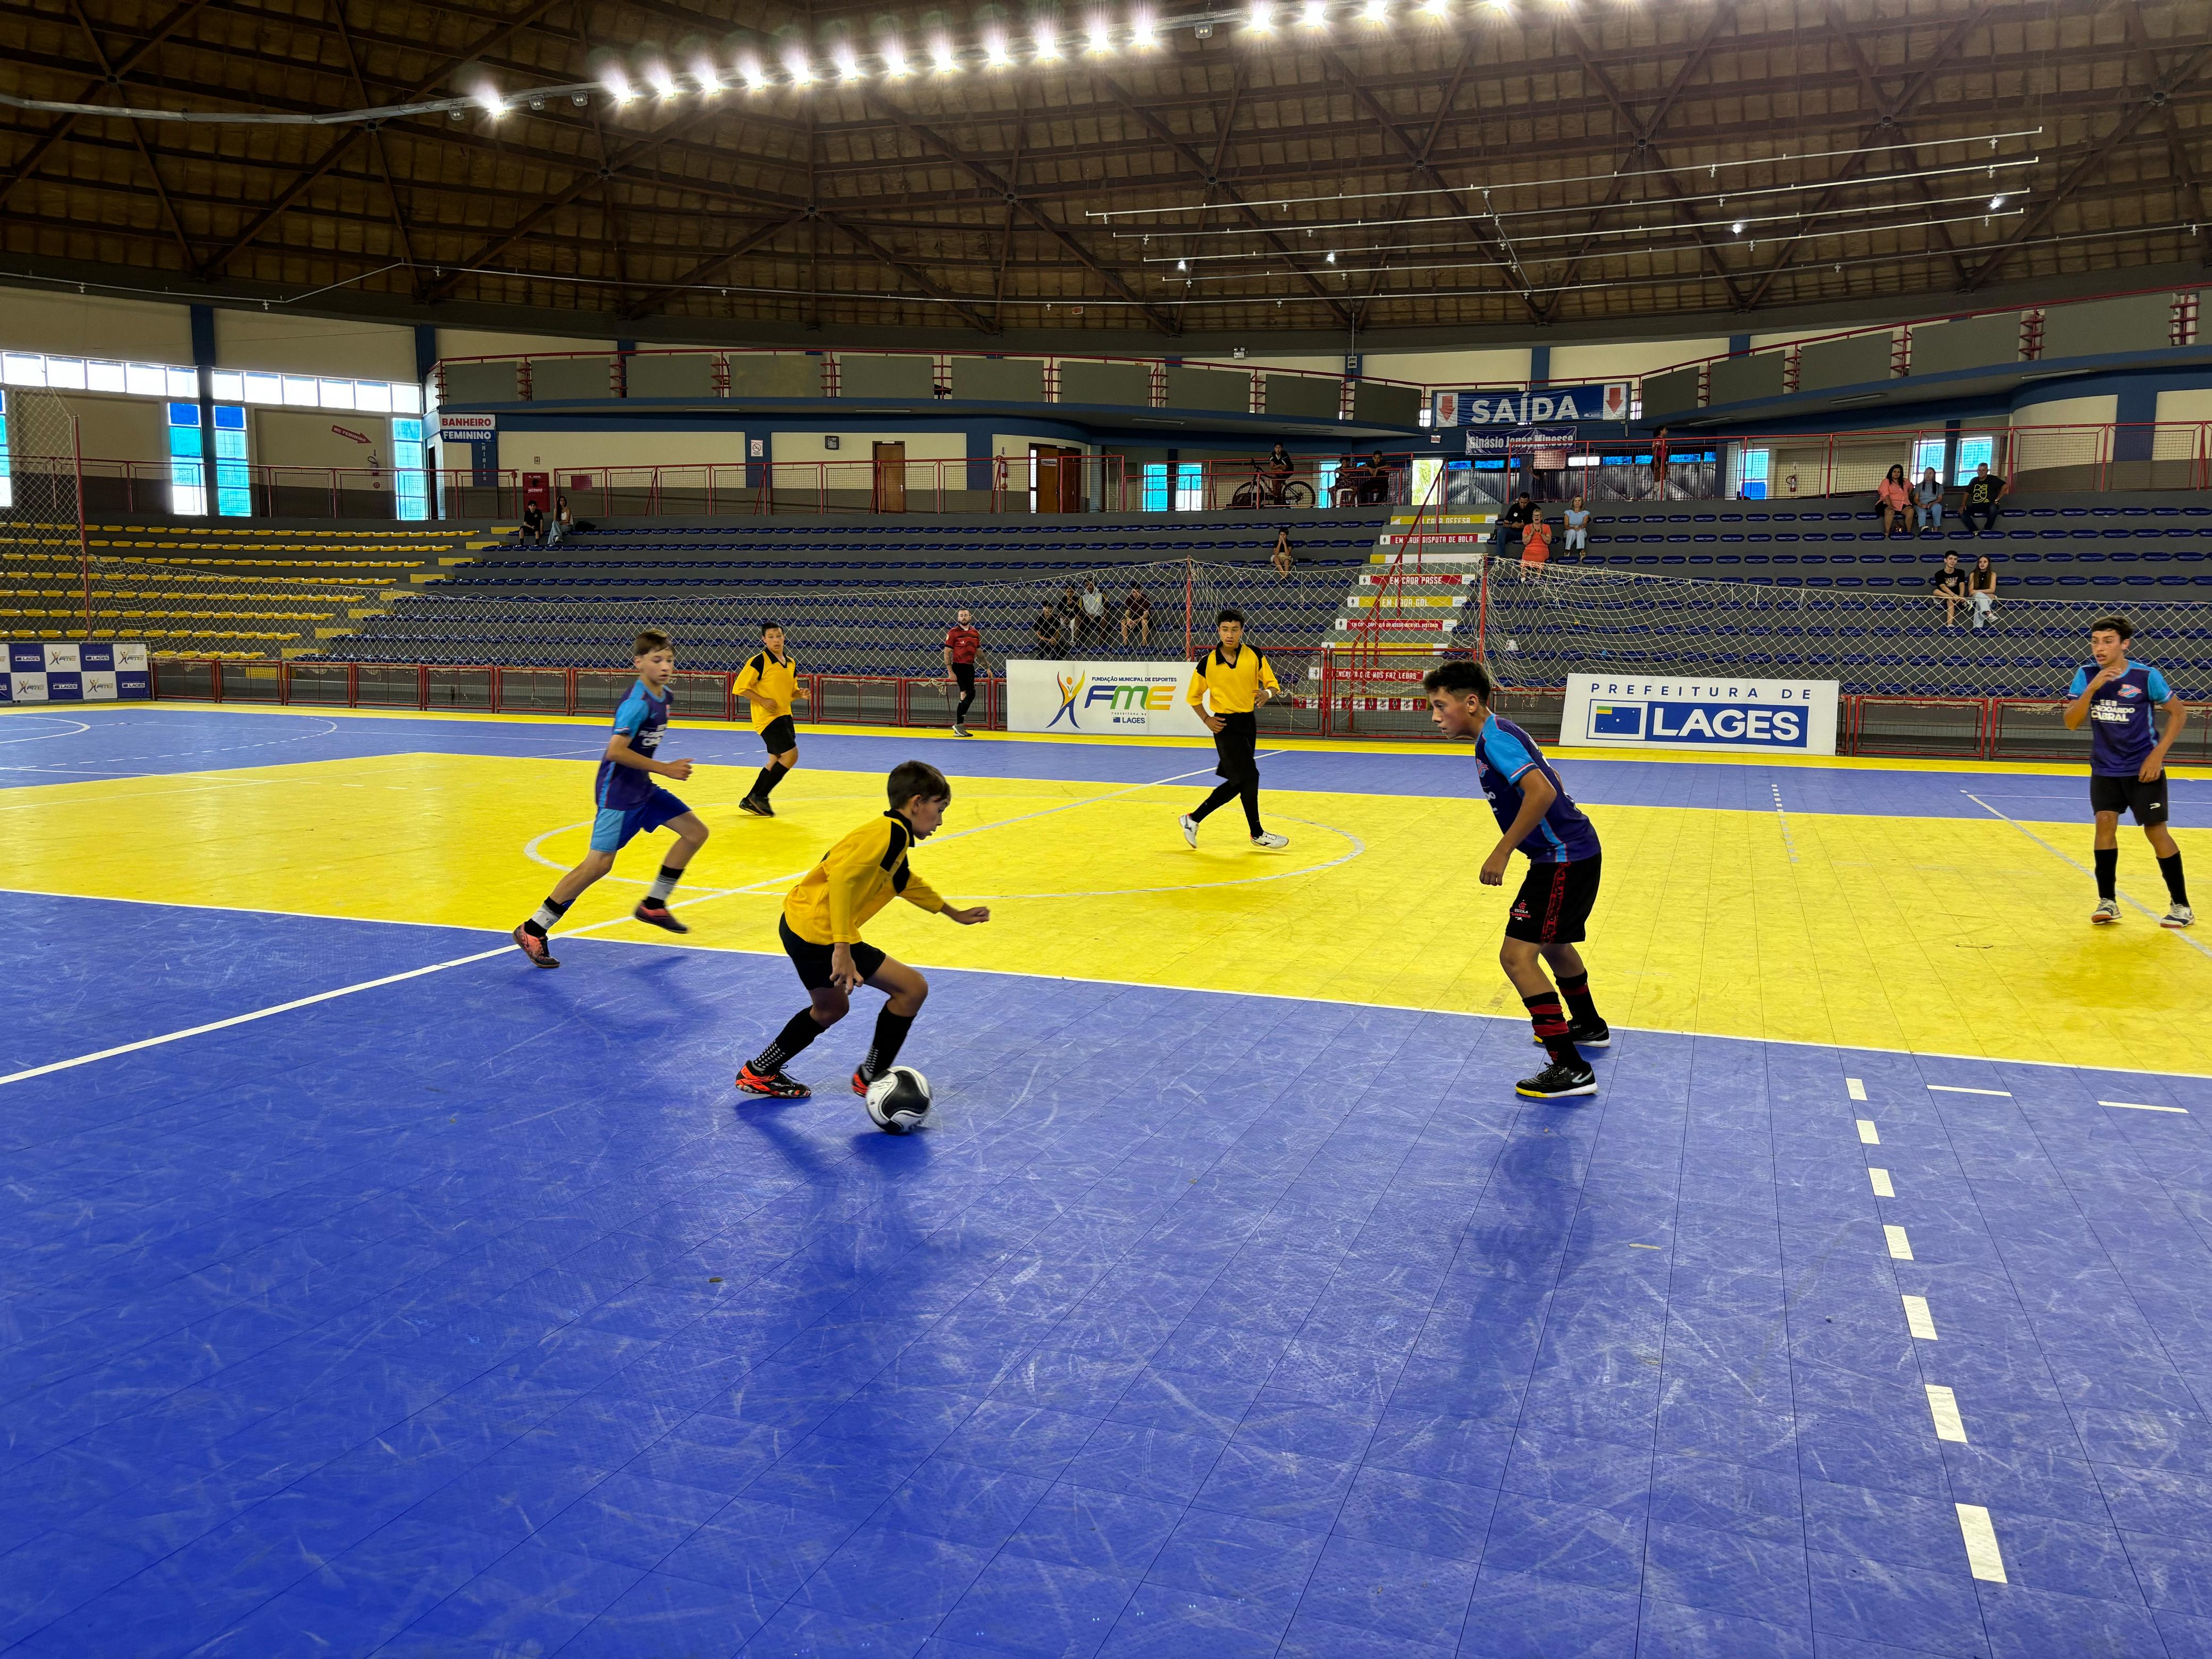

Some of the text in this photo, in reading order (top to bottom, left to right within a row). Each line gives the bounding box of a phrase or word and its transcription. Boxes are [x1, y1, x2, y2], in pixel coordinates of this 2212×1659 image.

[1471, 391, 1579, 423] SAÍDA
[442, 418, 491, 426] BANHEIRO
[342, 431, 366, 442] FEMININO
[443, 431, 491, 440] FEMININO
[1470, 435, 1504, 449] Ginásio
[1421, 576, 1442, 584] PASSE
[1084, 685, 1176, 711] FME
[1591, 683, 1811, 700] PREFEITURA DE
[2091, 710, 2130, 722] CABRAL
[1653, 708, 1799, 741] LAGES
